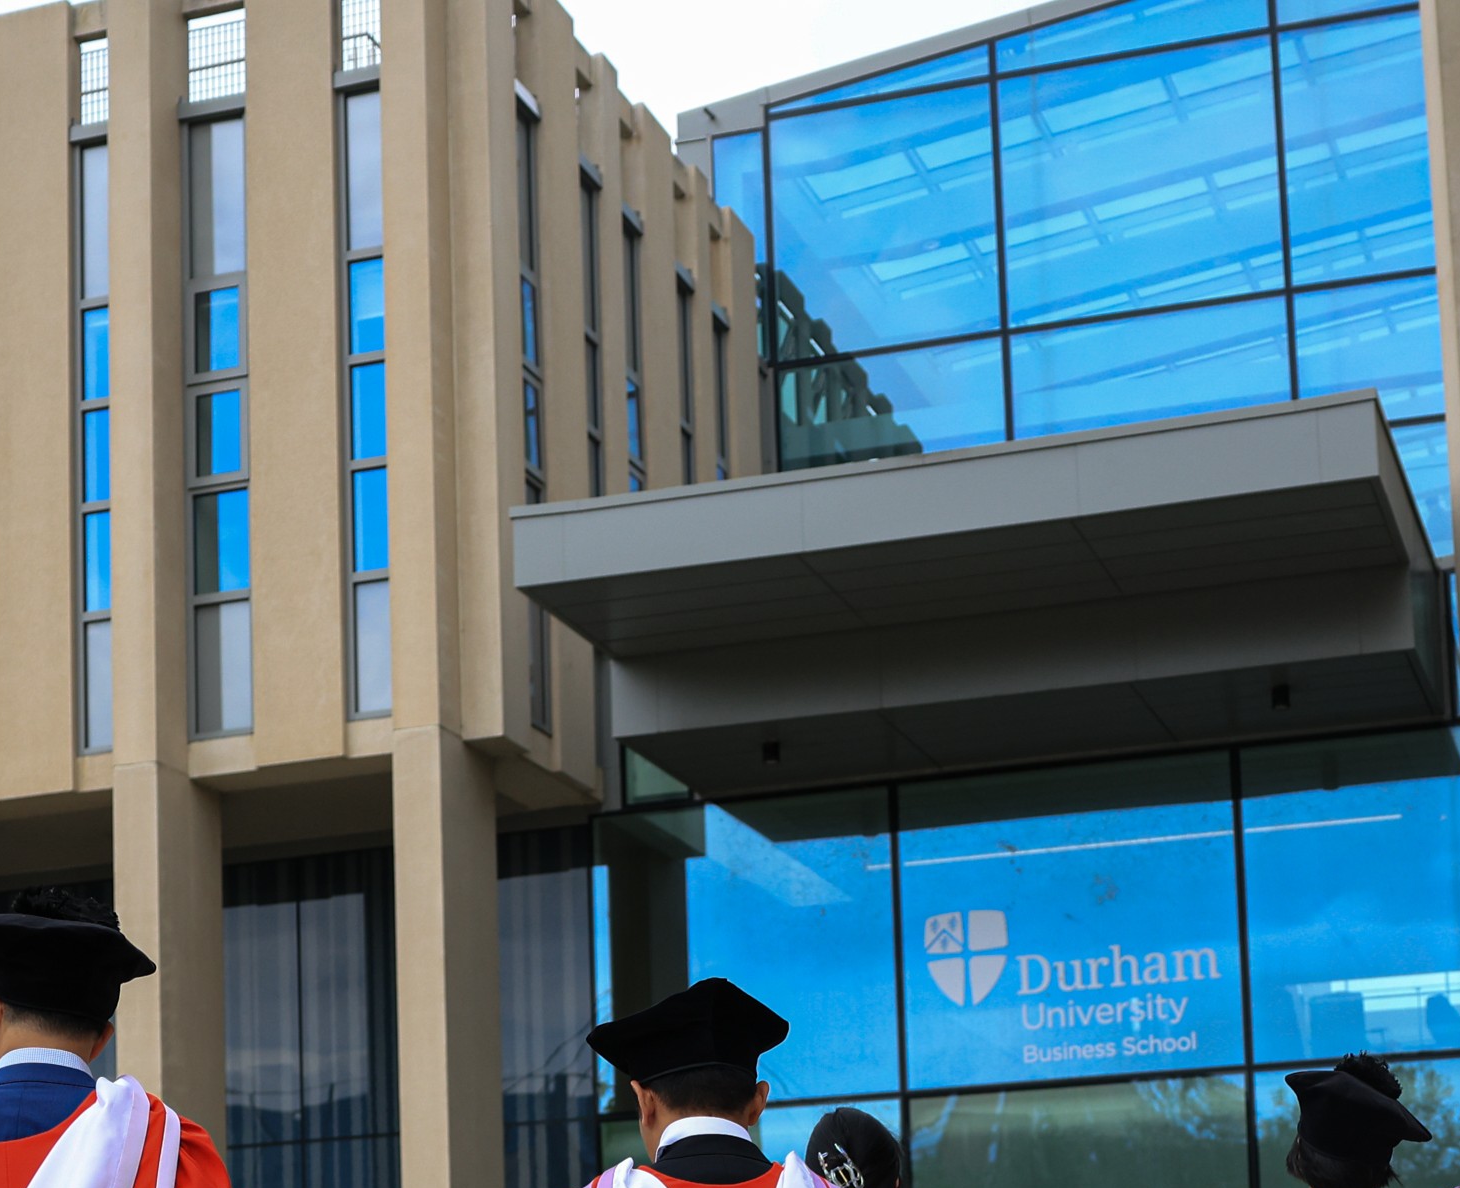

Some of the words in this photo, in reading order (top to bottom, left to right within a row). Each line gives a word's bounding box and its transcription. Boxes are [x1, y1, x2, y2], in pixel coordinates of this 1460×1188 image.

[1017, 944, 1221, 995] Durham
[1022, 992, 1188, 1030] University
[1024, 1040, 1116, 1063] Business
[1123, 1031, 1197, 1055] School
